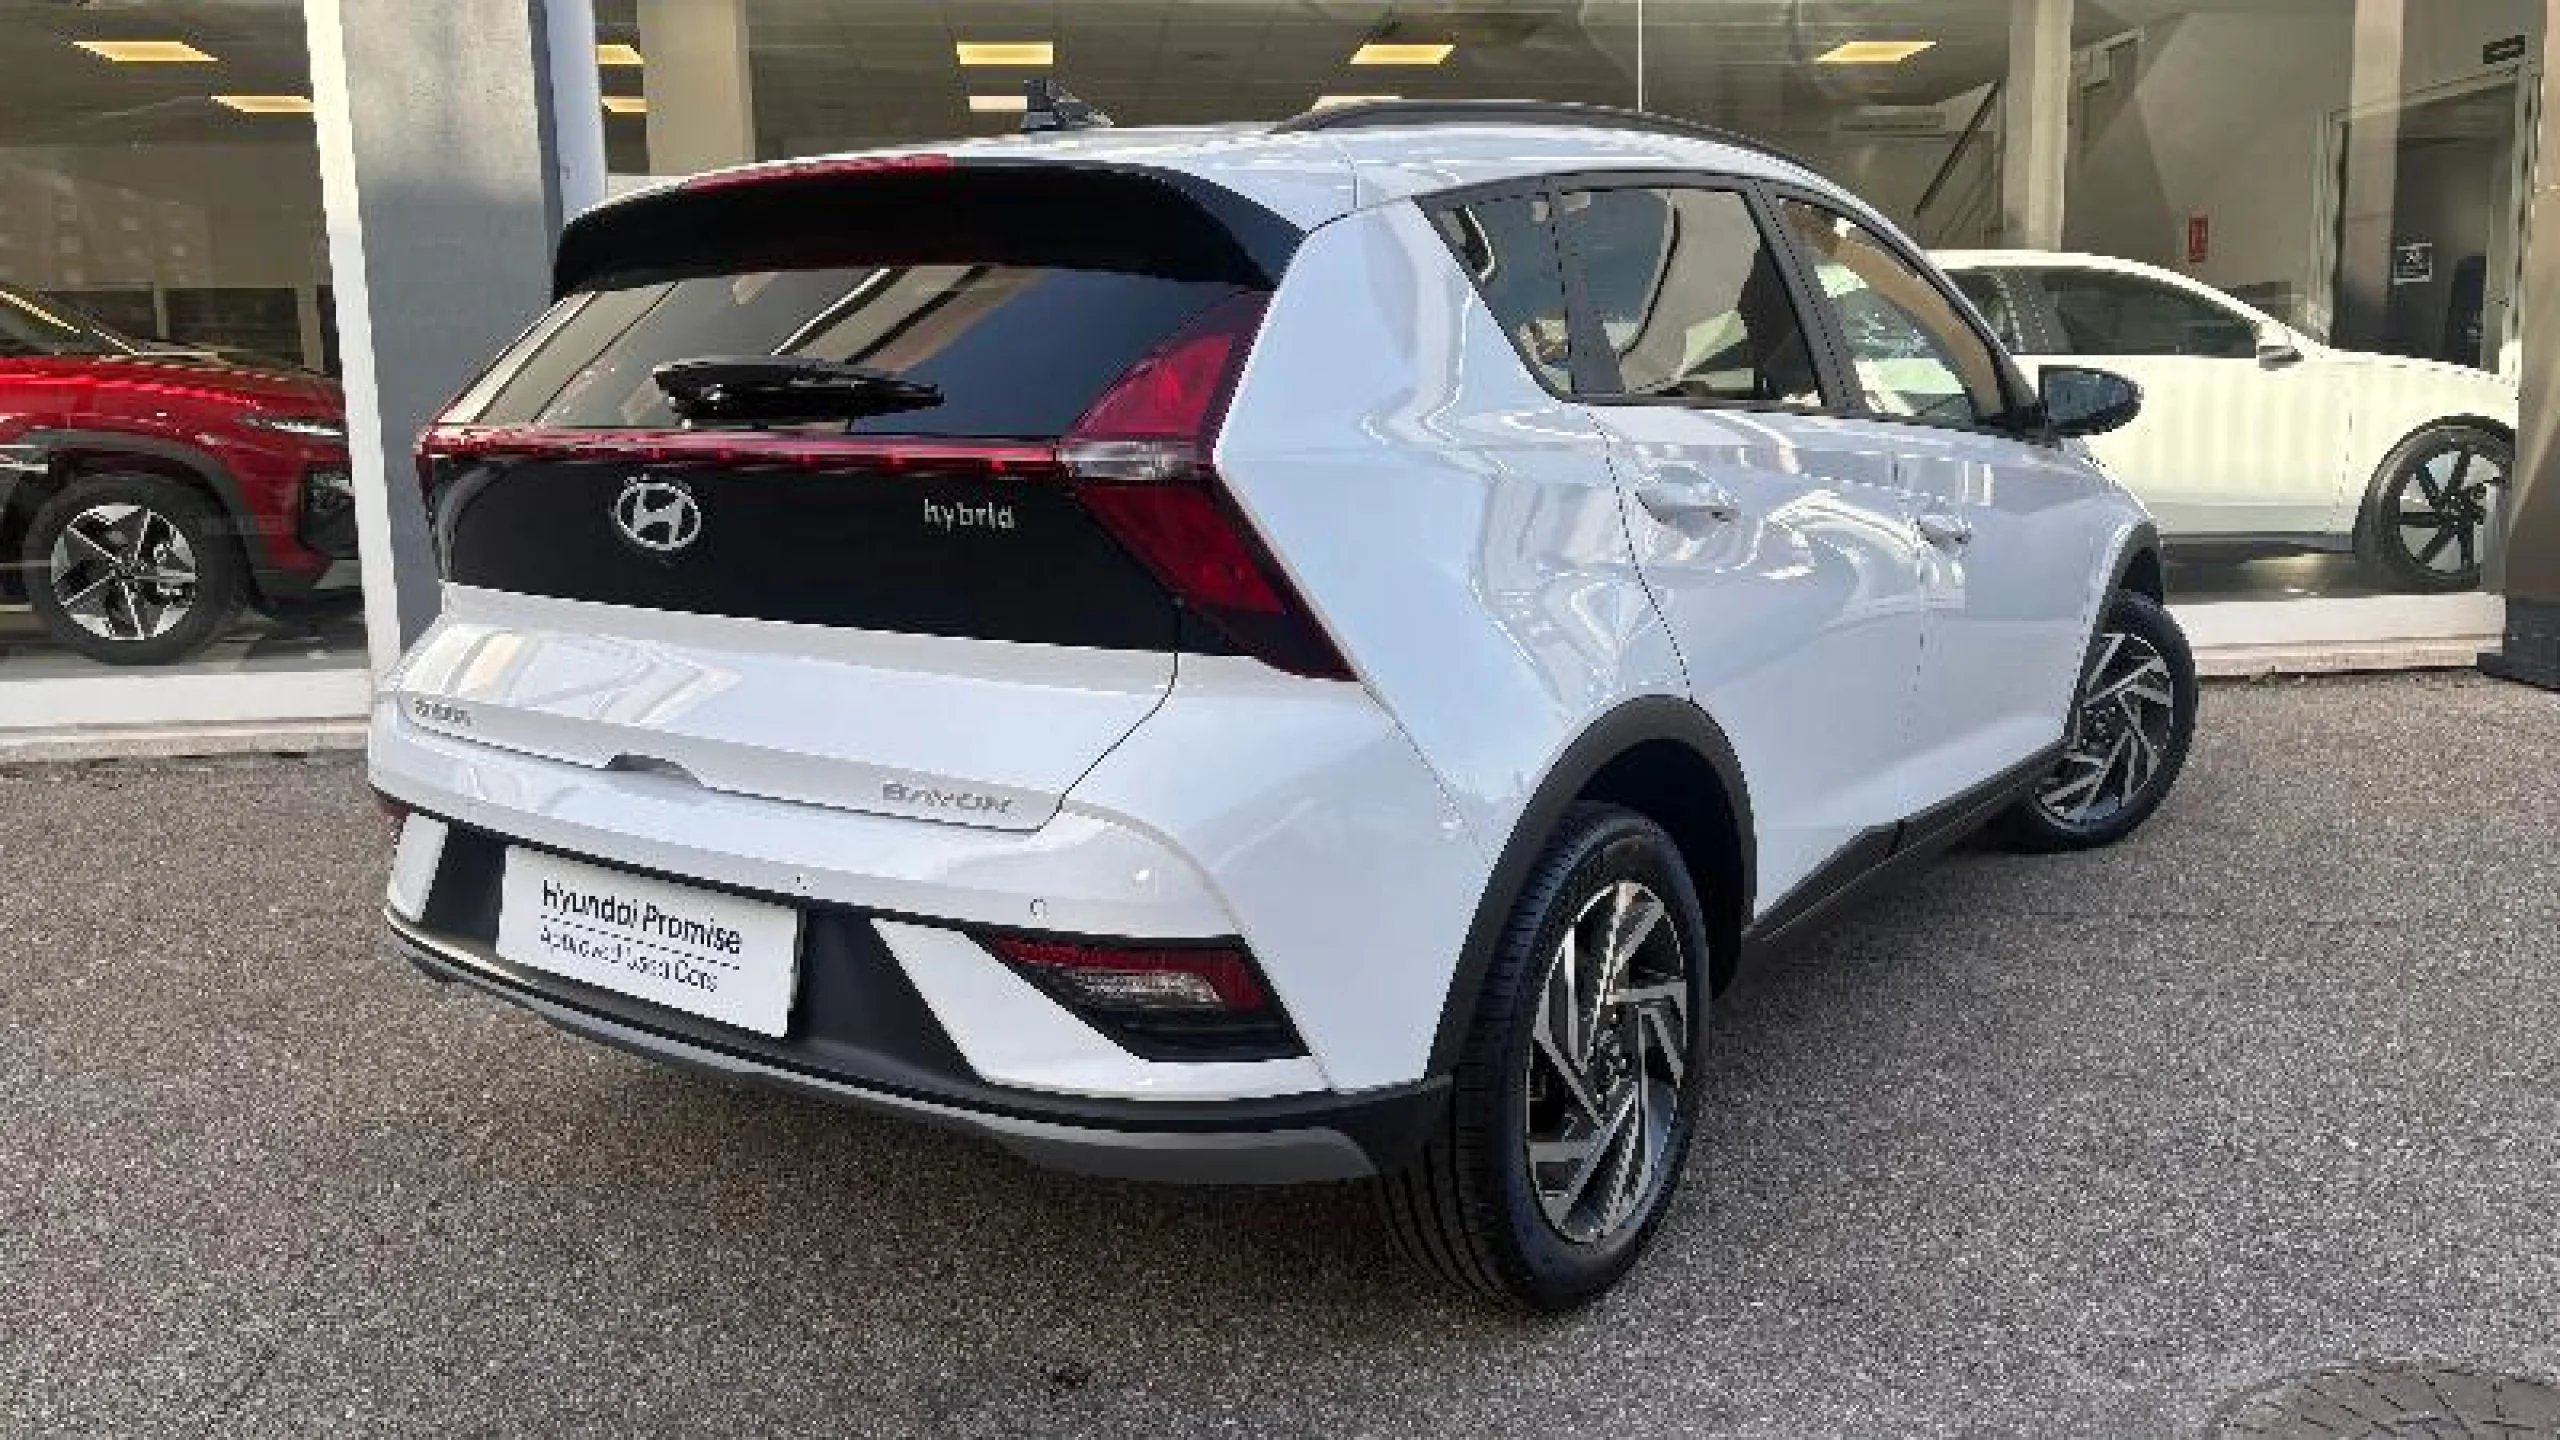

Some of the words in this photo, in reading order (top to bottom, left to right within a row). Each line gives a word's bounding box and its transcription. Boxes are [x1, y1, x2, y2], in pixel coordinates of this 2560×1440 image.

[924, 498, 1015, 532] hybrid
[543, 879, 638, 929] Hyundai
[642, 902, 741, 954] Promise
[674, 959, 718, 992] Cars
